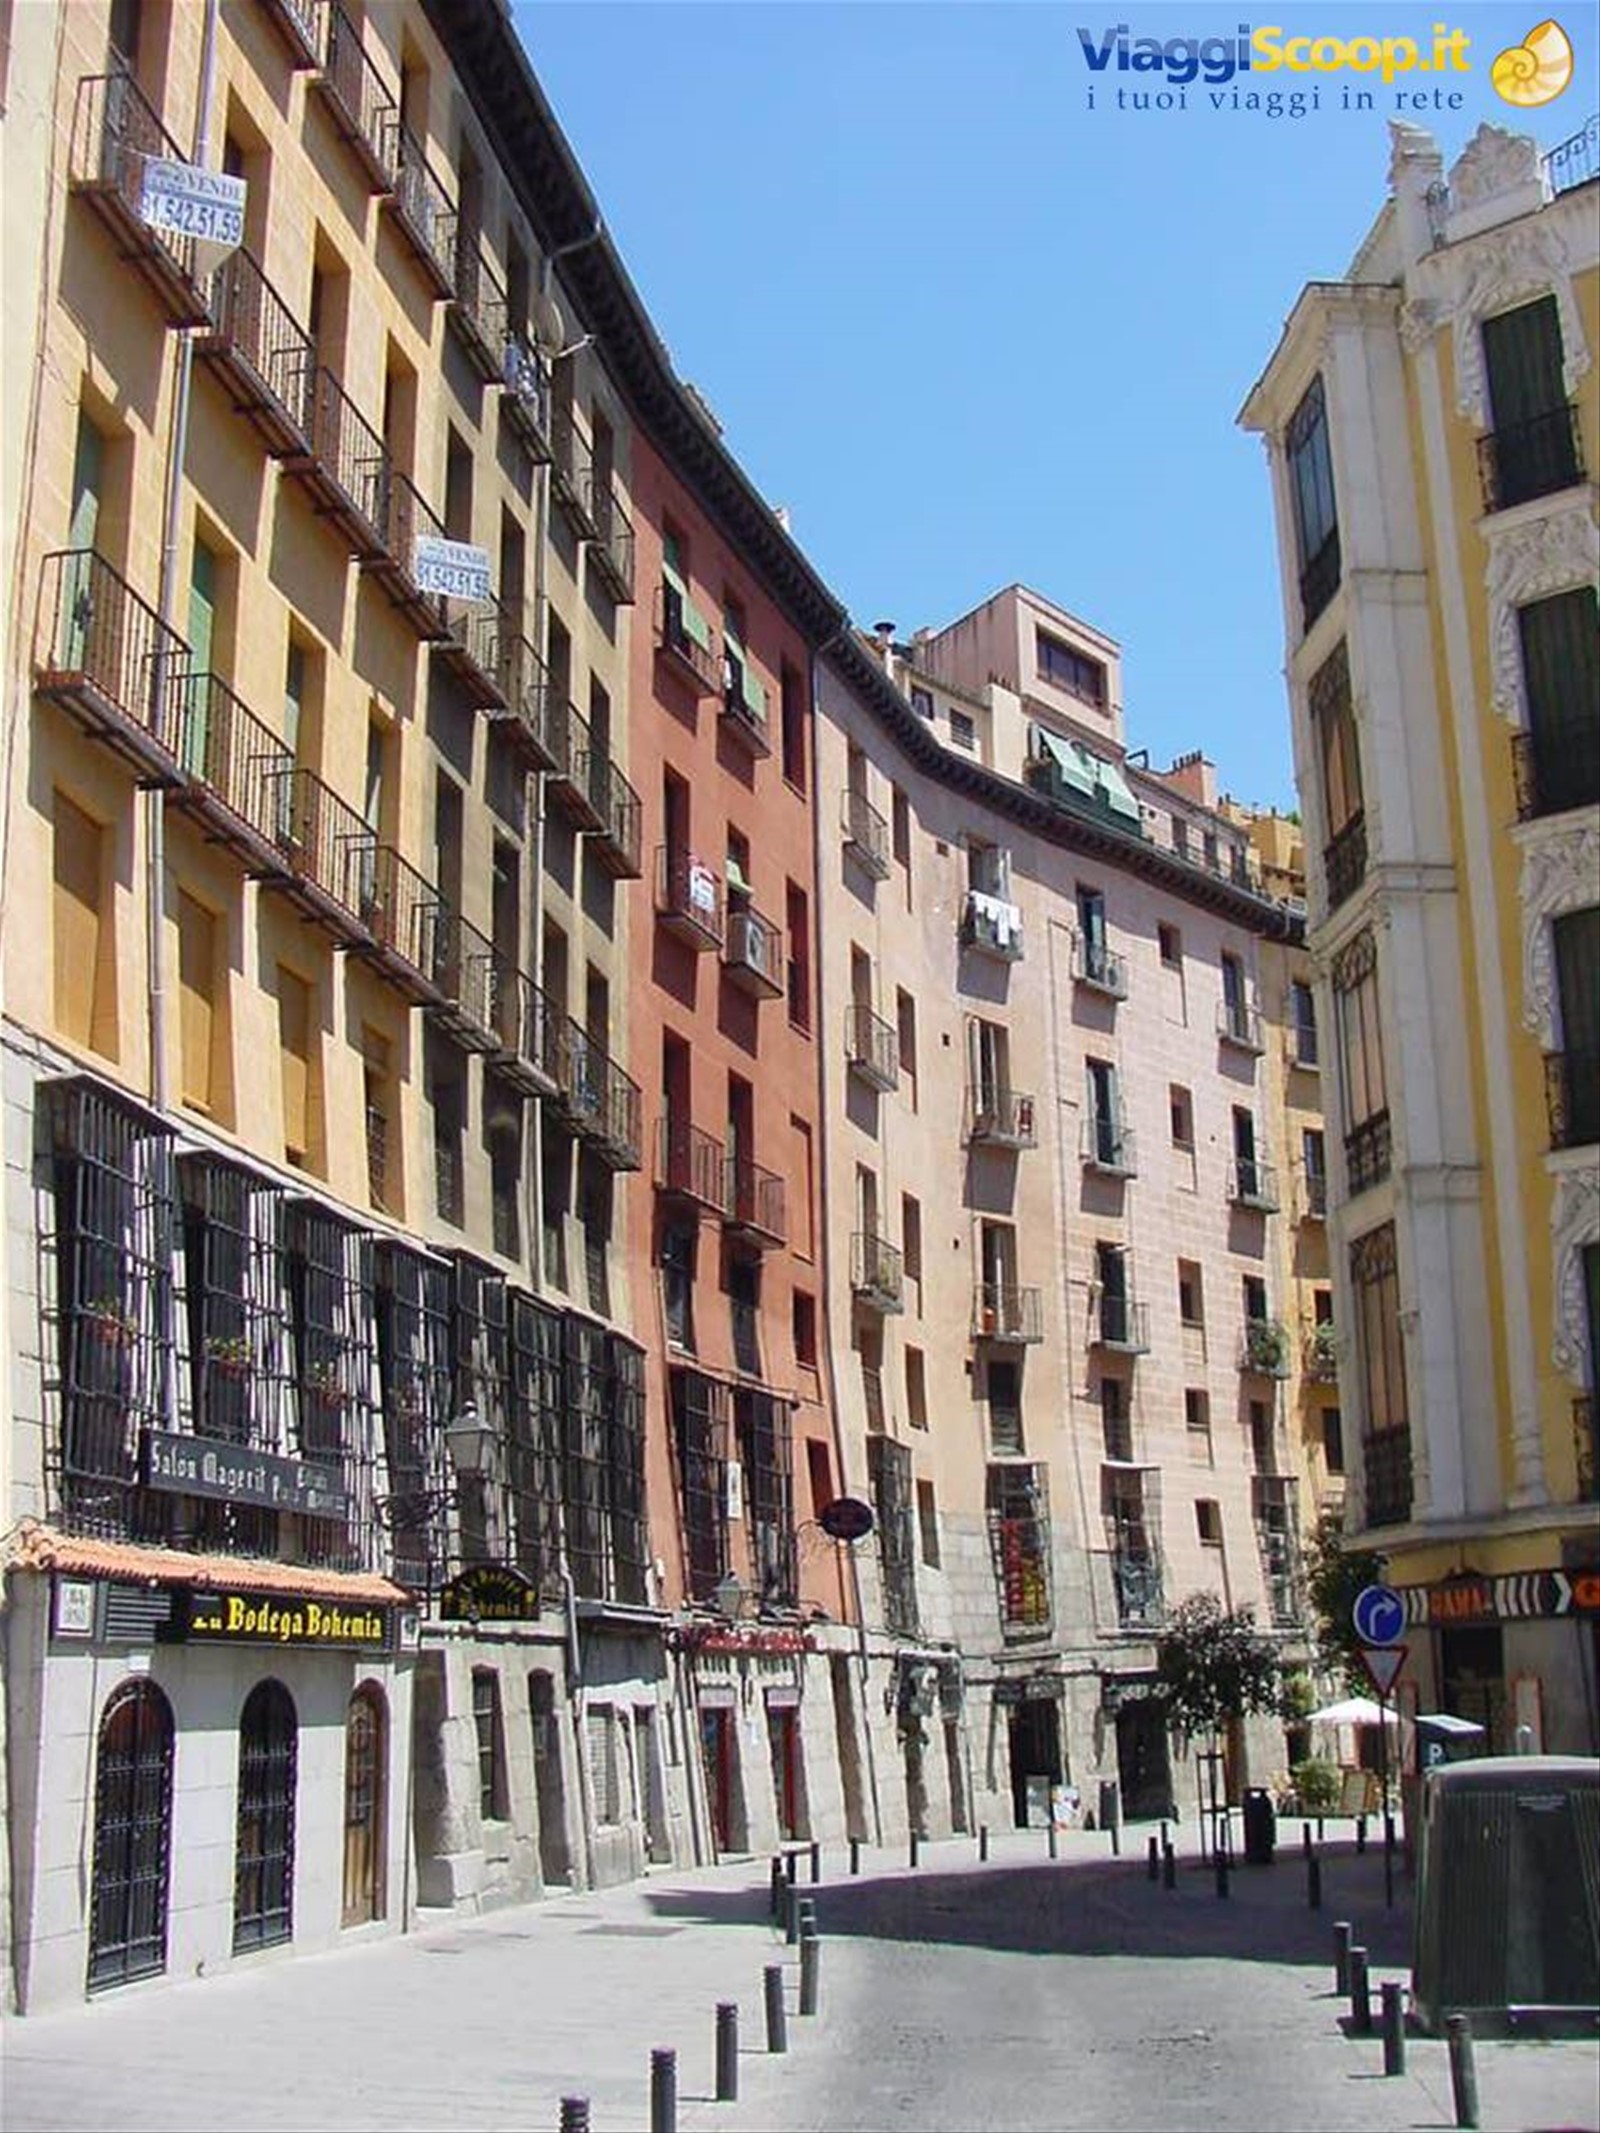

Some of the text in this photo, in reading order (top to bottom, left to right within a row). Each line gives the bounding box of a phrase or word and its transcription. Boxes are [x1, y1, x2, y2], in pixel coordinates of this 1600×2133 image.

[227, 1597, 304, 1641] Bodega
[306, 1603, 383, 1638] Bohemia
[1429, 1743, 1443, 1764] P
